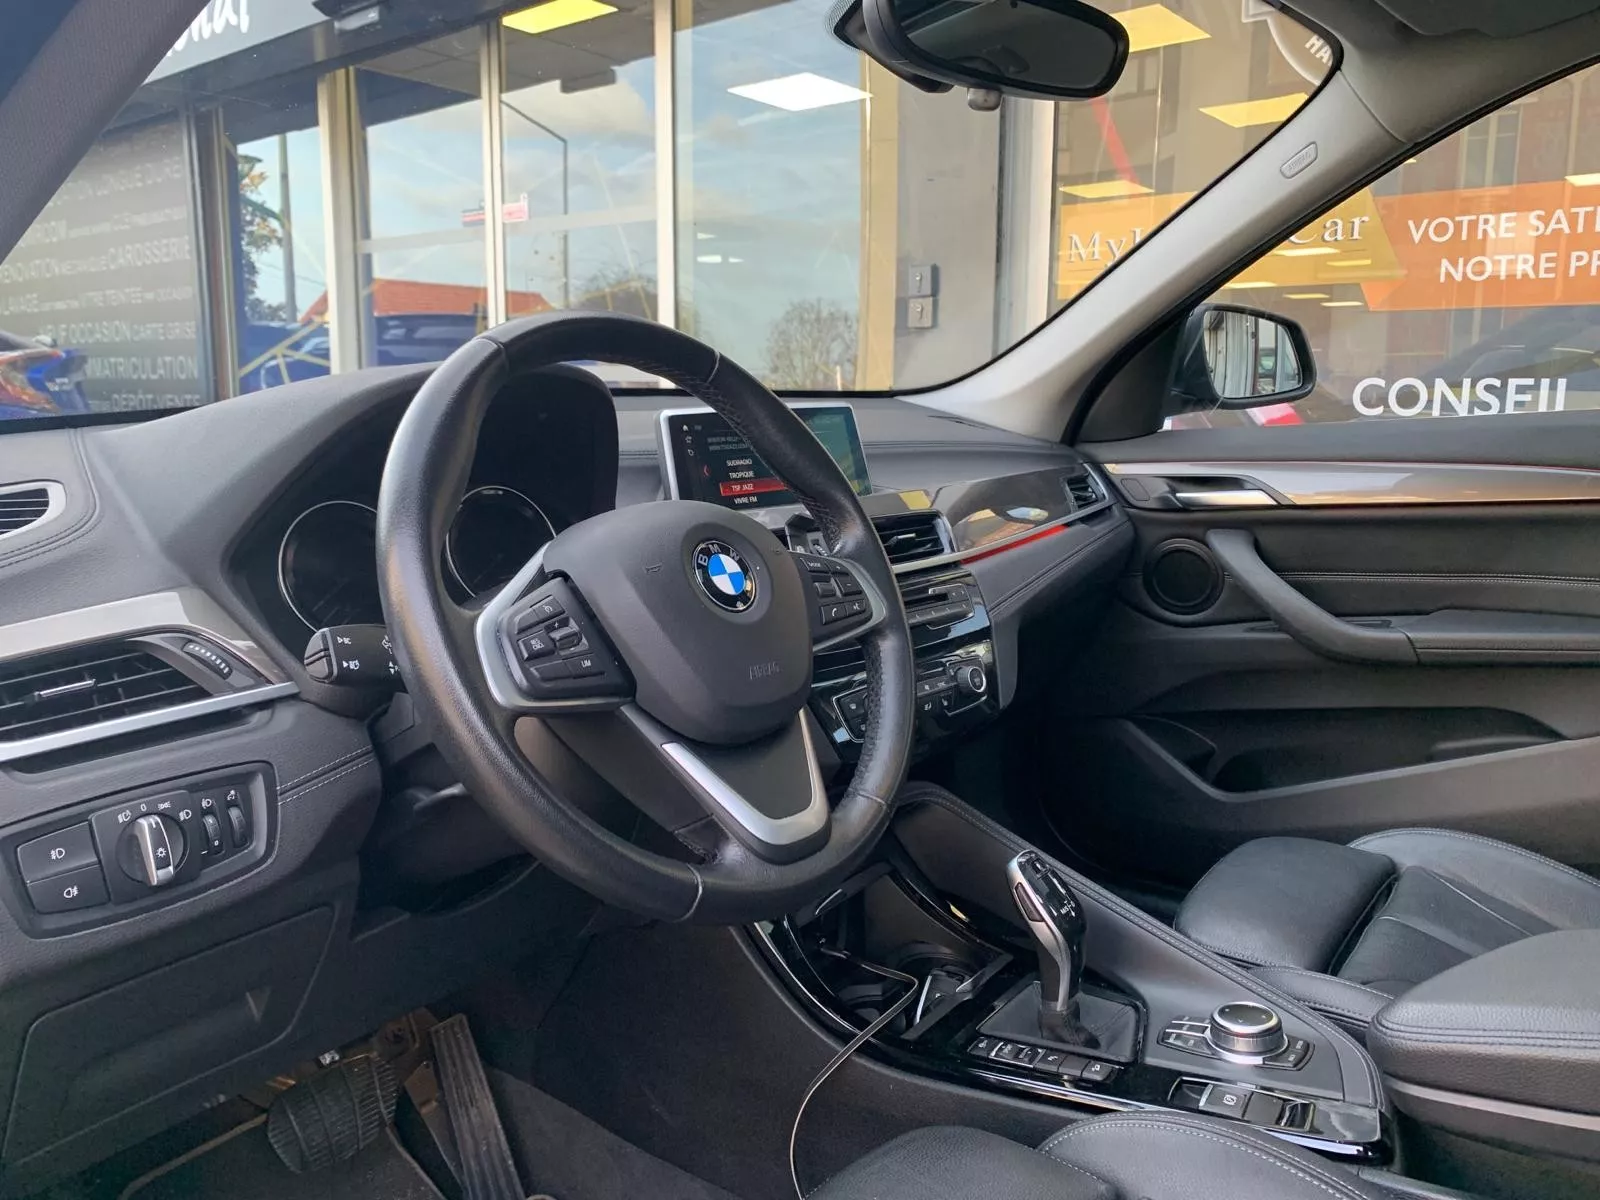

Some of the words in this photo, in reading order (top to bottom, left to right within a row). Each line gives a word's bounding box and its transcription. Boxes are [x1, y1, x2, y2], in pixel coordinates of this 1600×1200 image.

[1407, 211, 1518, 245] VOTRE
[1439, 251, 1558, 284] NOTRE
[697, 543, 740, 566] BMW
